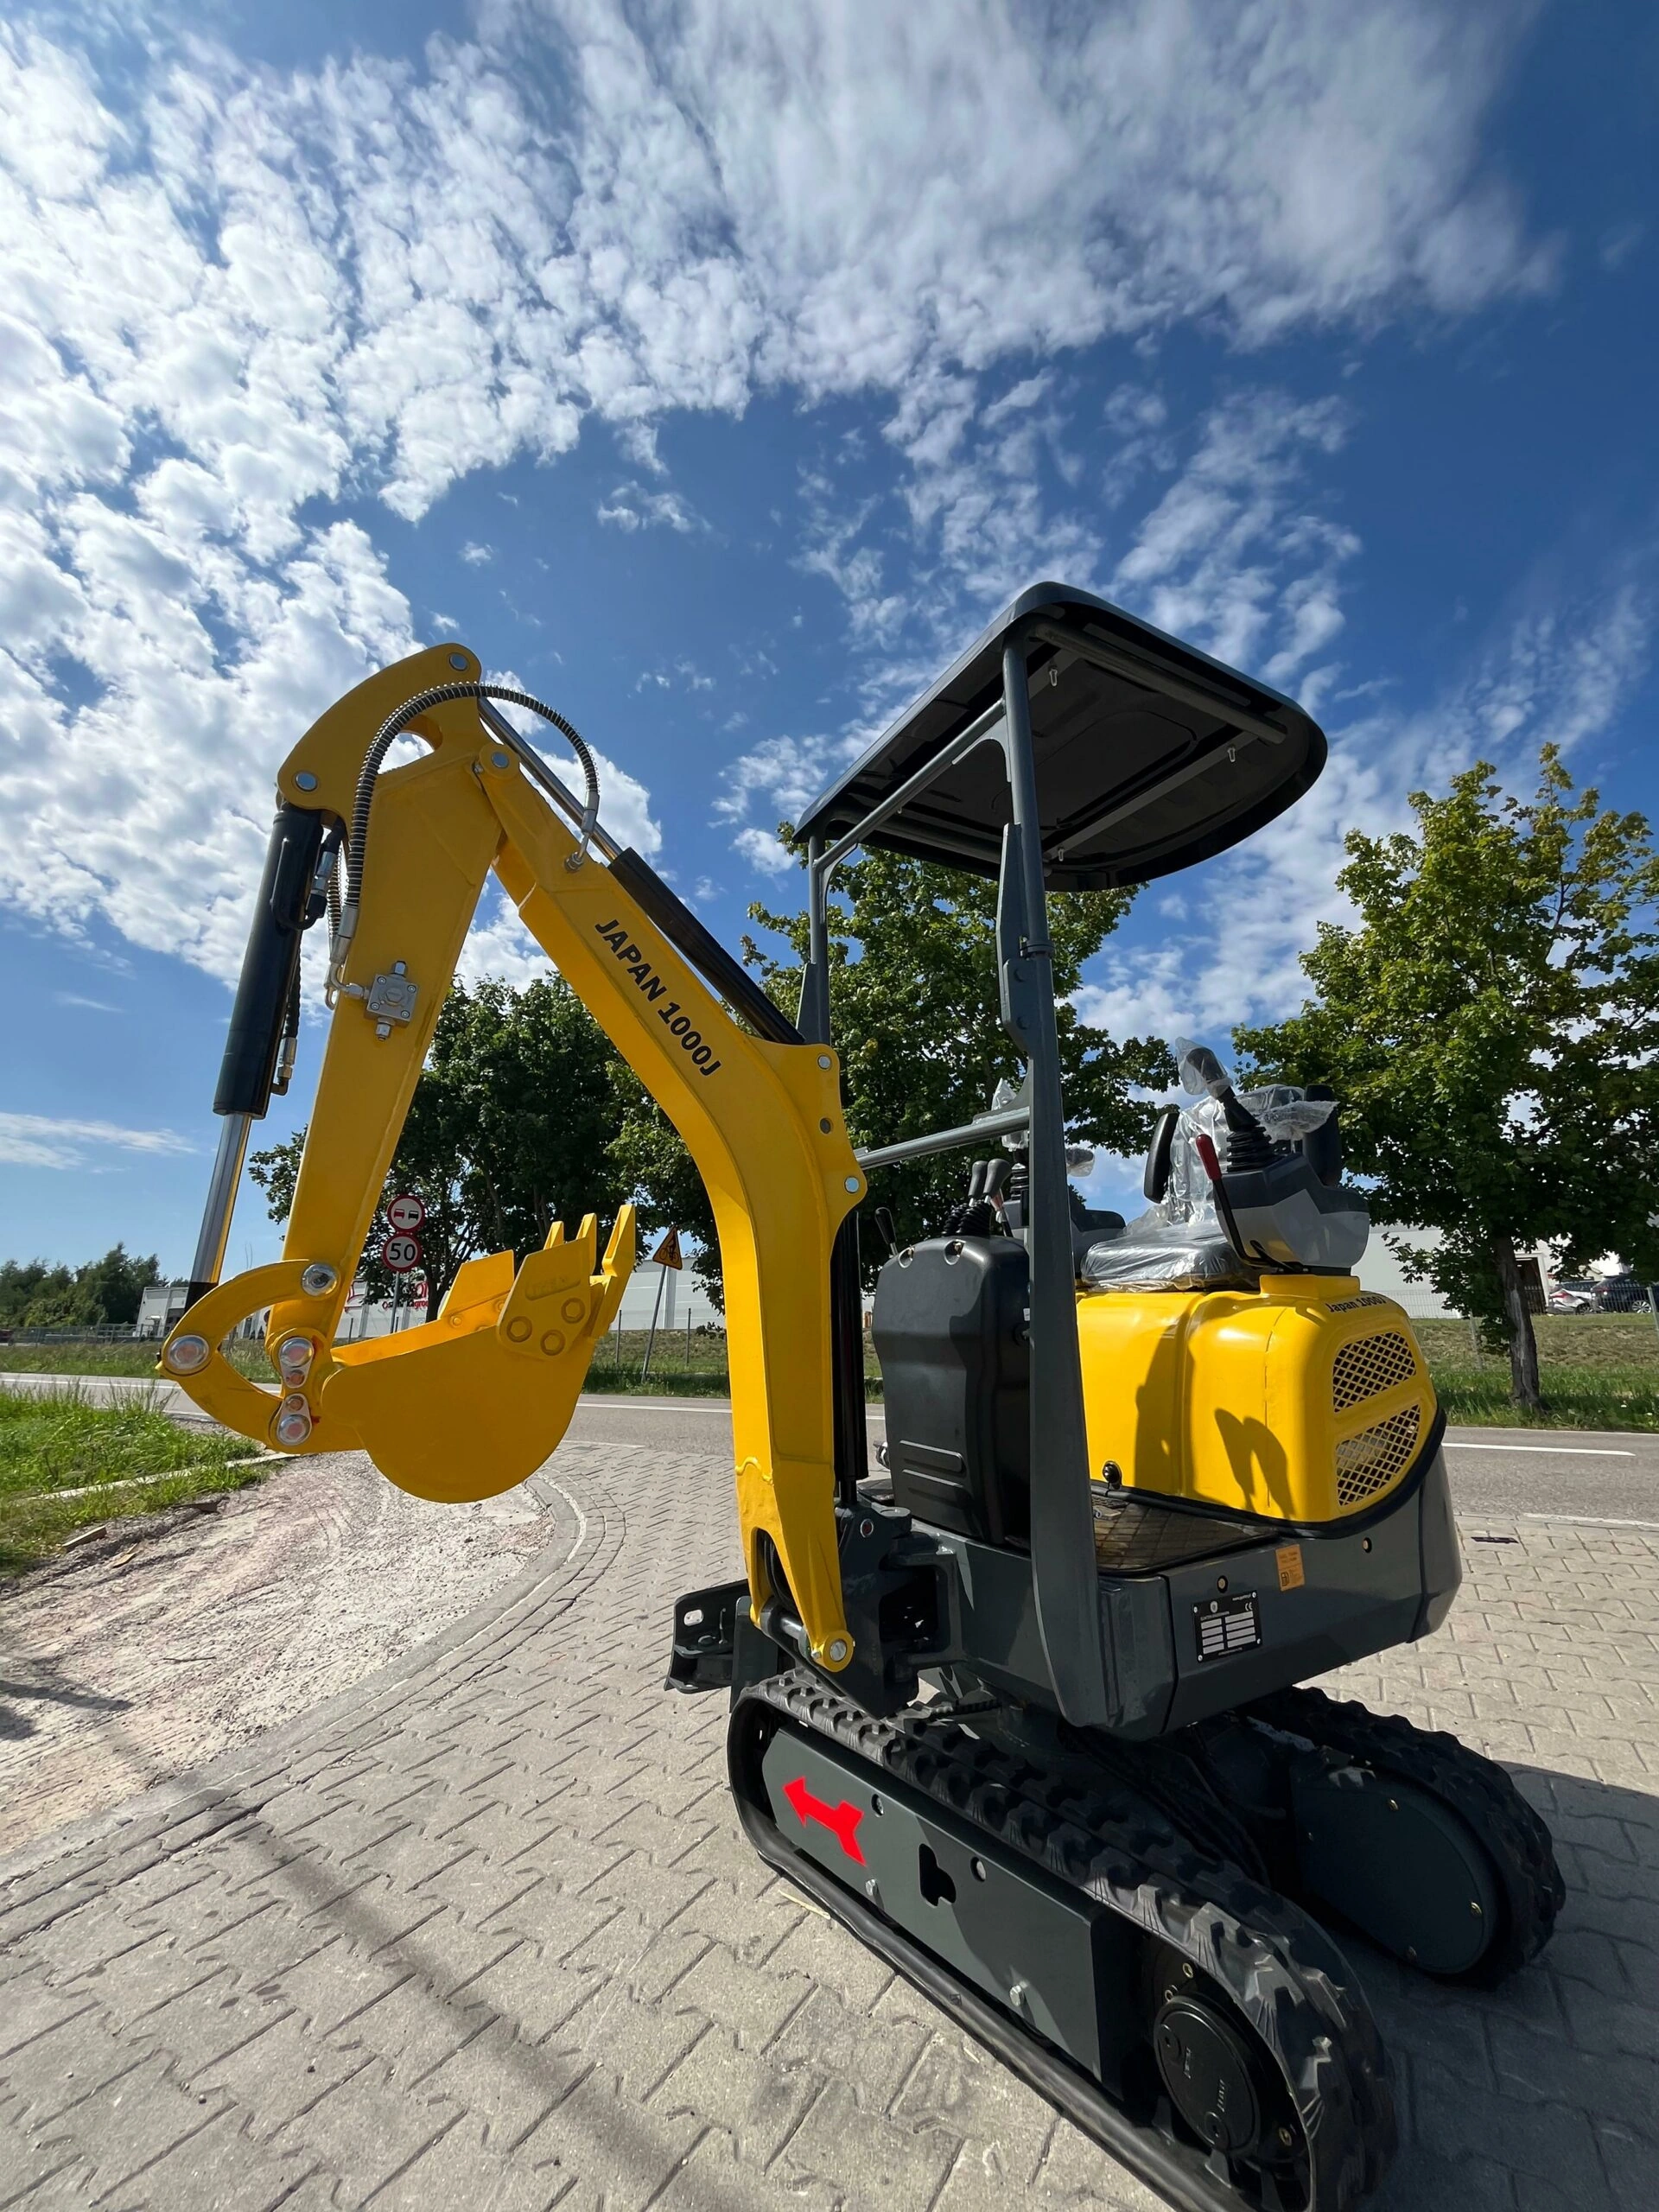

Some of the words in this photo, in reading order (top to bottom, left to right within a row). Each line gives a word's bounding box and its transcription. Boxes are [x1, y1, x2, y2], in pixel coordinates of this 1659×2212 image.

[594, 919, 667, 1002] JAPAN
[658, 1001, 722, 1076] 1000J
[389, 1243, 416, 1262] 50
[1325, 1302, 1360, 1313] Japan
